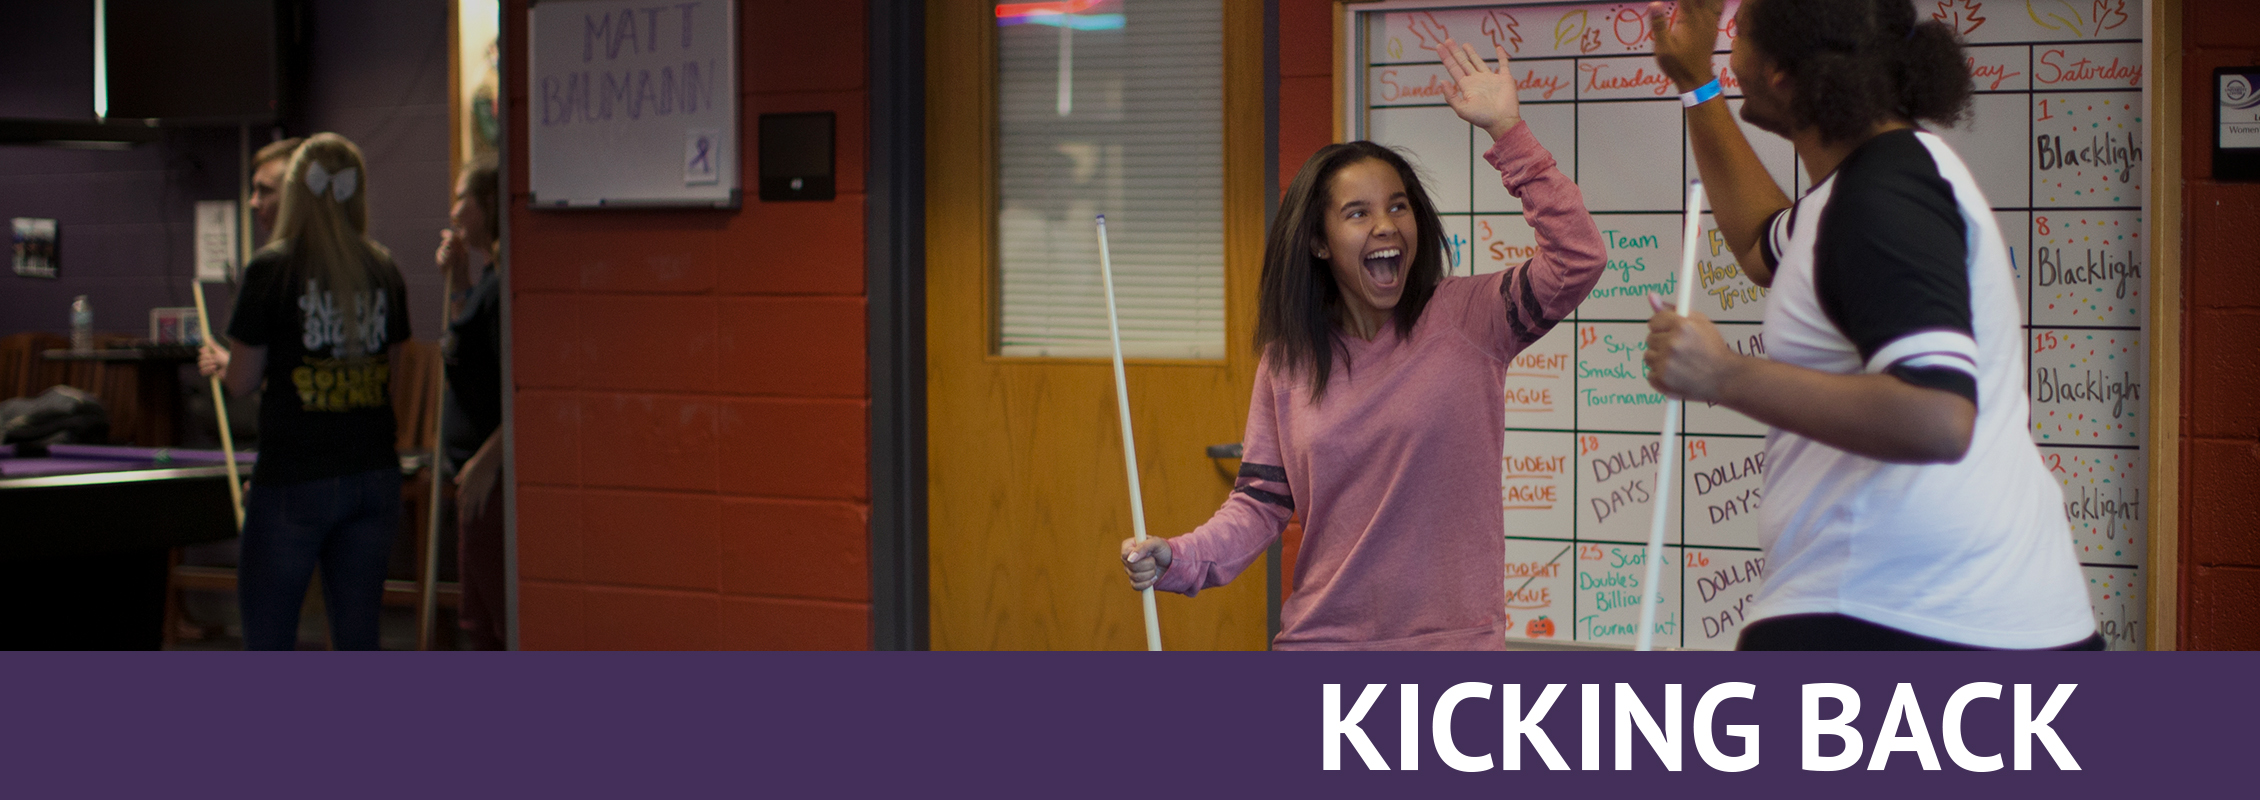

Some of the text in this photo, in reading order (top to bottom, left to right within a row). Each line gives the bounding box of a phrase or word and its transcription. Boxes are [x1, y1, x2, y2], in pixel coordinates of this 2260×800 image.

[582, 3, 702, 62] MATT
[2035, 50, 2142, 86] Saturday
[541, 59, 716, 126] BAUMANN
[2037, 99, 2053, 121] 1
[2229, 125, 2260, 134] Women
[2037, 131, 2142, 183] Blackligh
[1478, 220, 1493, 241] 3
[2036, 216, 2050, 236] 8
[1602, 230, 1658, 249] Team
[1489, 241, 1541, 262] STUD
[1605, 257, 1646, 282] ags
[2038, 246, 2141, 300] Blackligh
[1588, 271, 1678, 299] ournament
[2034, 331, 2058, 354] 15
[1579, 360, 1636, 379] Smash
[1505, 388, 1553, 405] AGUE
[1580, 388, 1667, 407] Tournamen
[2037, 367, 2140, 419] Blackligh
[1579, 436, 1599, 456] 18
[1688, 440, 1707, 462] 19
[1502, 456, 1566, 474] TUDENT
[2041, 453, 2066, 473] 2
[1591, 480, 1650, 523] DAYS
[2063, 486, 2140, 541] cklight
[1579, 545, 1603, 560] 25
[1686, 552, 1710, 568] 26
[1505, 562, 1560, 578] TUDENT
[1579, 571, 1639, 591] Doubles
[1505, 588, 1551, 604] AGUE
[1579, 612, 1677, 641] Tournant
